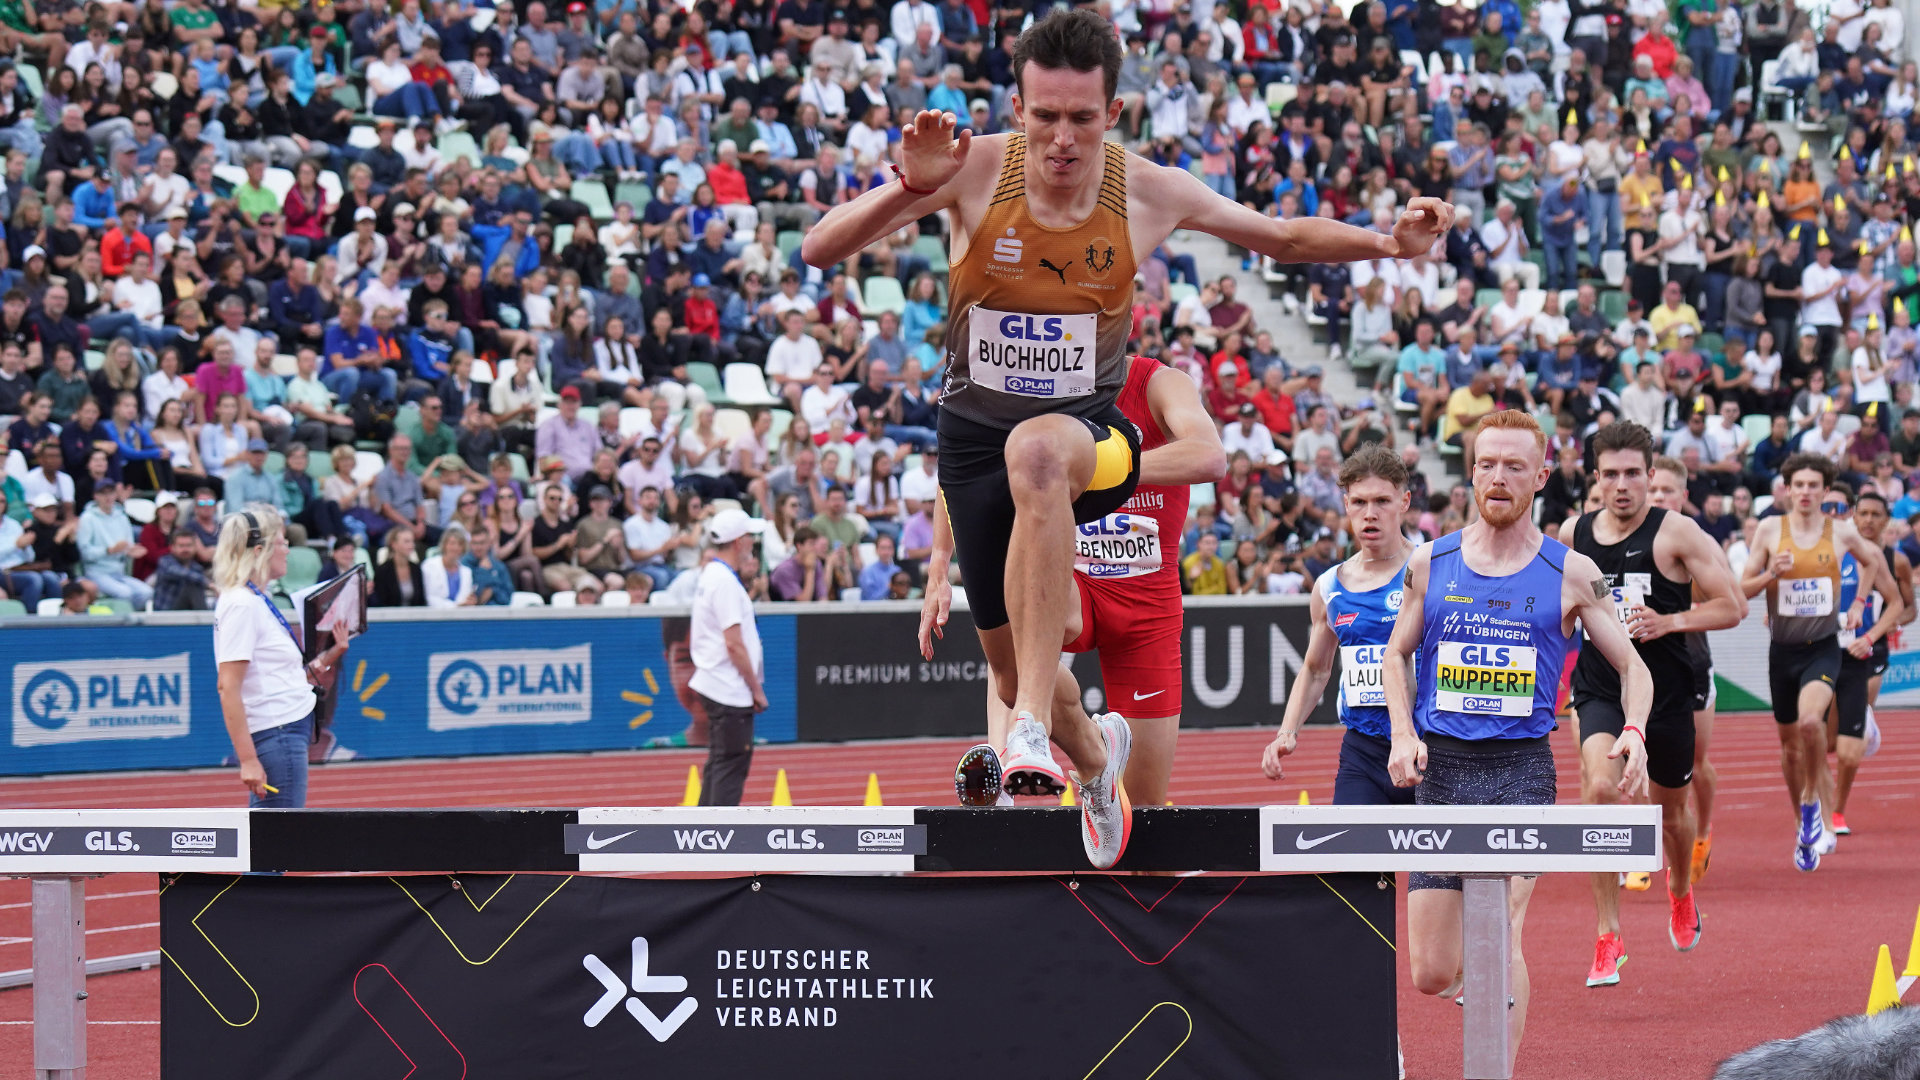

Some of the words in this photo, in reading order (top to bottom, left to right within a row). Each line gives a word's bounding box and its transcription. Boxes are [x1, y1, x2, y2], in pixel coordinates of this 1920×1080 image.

[986, 262, 1024, 274] Sparkasse
[1000, 315, 1073, 341] GLS.
[979, 338, 1085, 373] BUCHHOLZ
[1025, 380, 1052, 390] PLAN
[1076, 535, 1155, 559] BENDORF
[1105, 563, 1128, 572] PLAN
[1792, 579, 1823, 592] GLS.
[1487, 599, 1511, 610] gmg
[1464, 612, 1489, 623] LAV
[1490, 617, 1531, 629] Stadtwerke
[1464, 624, 1530, 641] TÜBINGEN
[1461, 645, 1518, 667] GLS.
[498, 663, 583, 695] PLAN
[816, 664, 911, 684] PREMIUM
[1441, 667, 1532, 693] RUPPERT
[88, 673, 182, 708] PLAN
[498, 701, 583, 713] INTERNATIONAL
[1479, 700, 1501, 708] PLAN
[88, 714, 182, 727] INTERNATIONAL
[85, 831, 141, 851] GLS.
[674, 829, 735, 850] WGV
[767, 829, 825, 850] GLS.
[1388, 829, 1452, 850] WGV
[1486, 829, 1547, 850] GLS.
[1603, 832, 1629, 840] PLAN
[717, 950, 870, 970] DEUTSCHER
[716, 978, 934, 998] LEICHTATHLETIK
[715, 1007, 838, 1027] VERBAND
